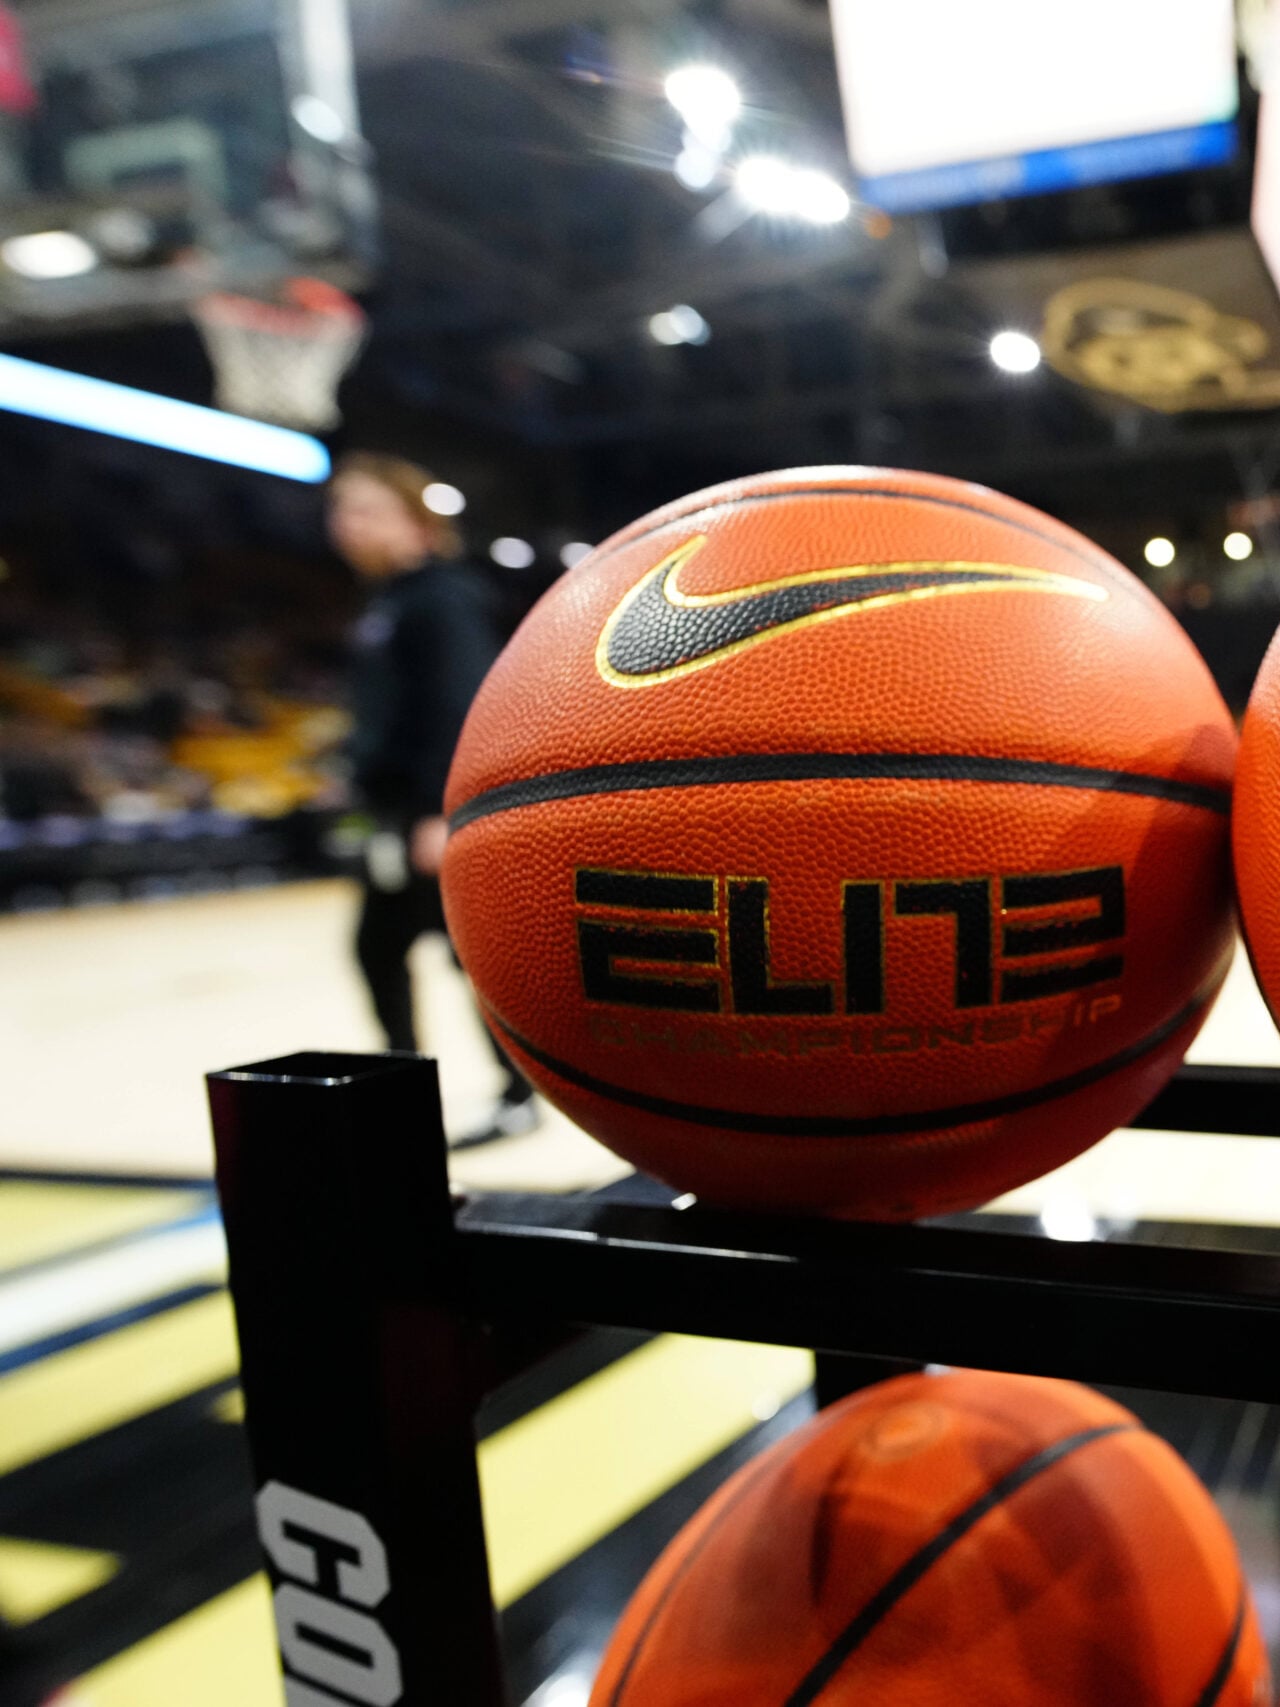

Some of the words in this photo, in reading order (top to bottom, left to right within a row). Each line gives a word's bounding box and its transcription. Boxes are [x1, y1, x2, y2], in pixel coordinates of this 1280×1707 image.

[574, 864, 1126, 1015] ELITE
[588, 994, 1122, 1057] CHAMPIONSHIP
[255, 1479, 404, 1707] CO
